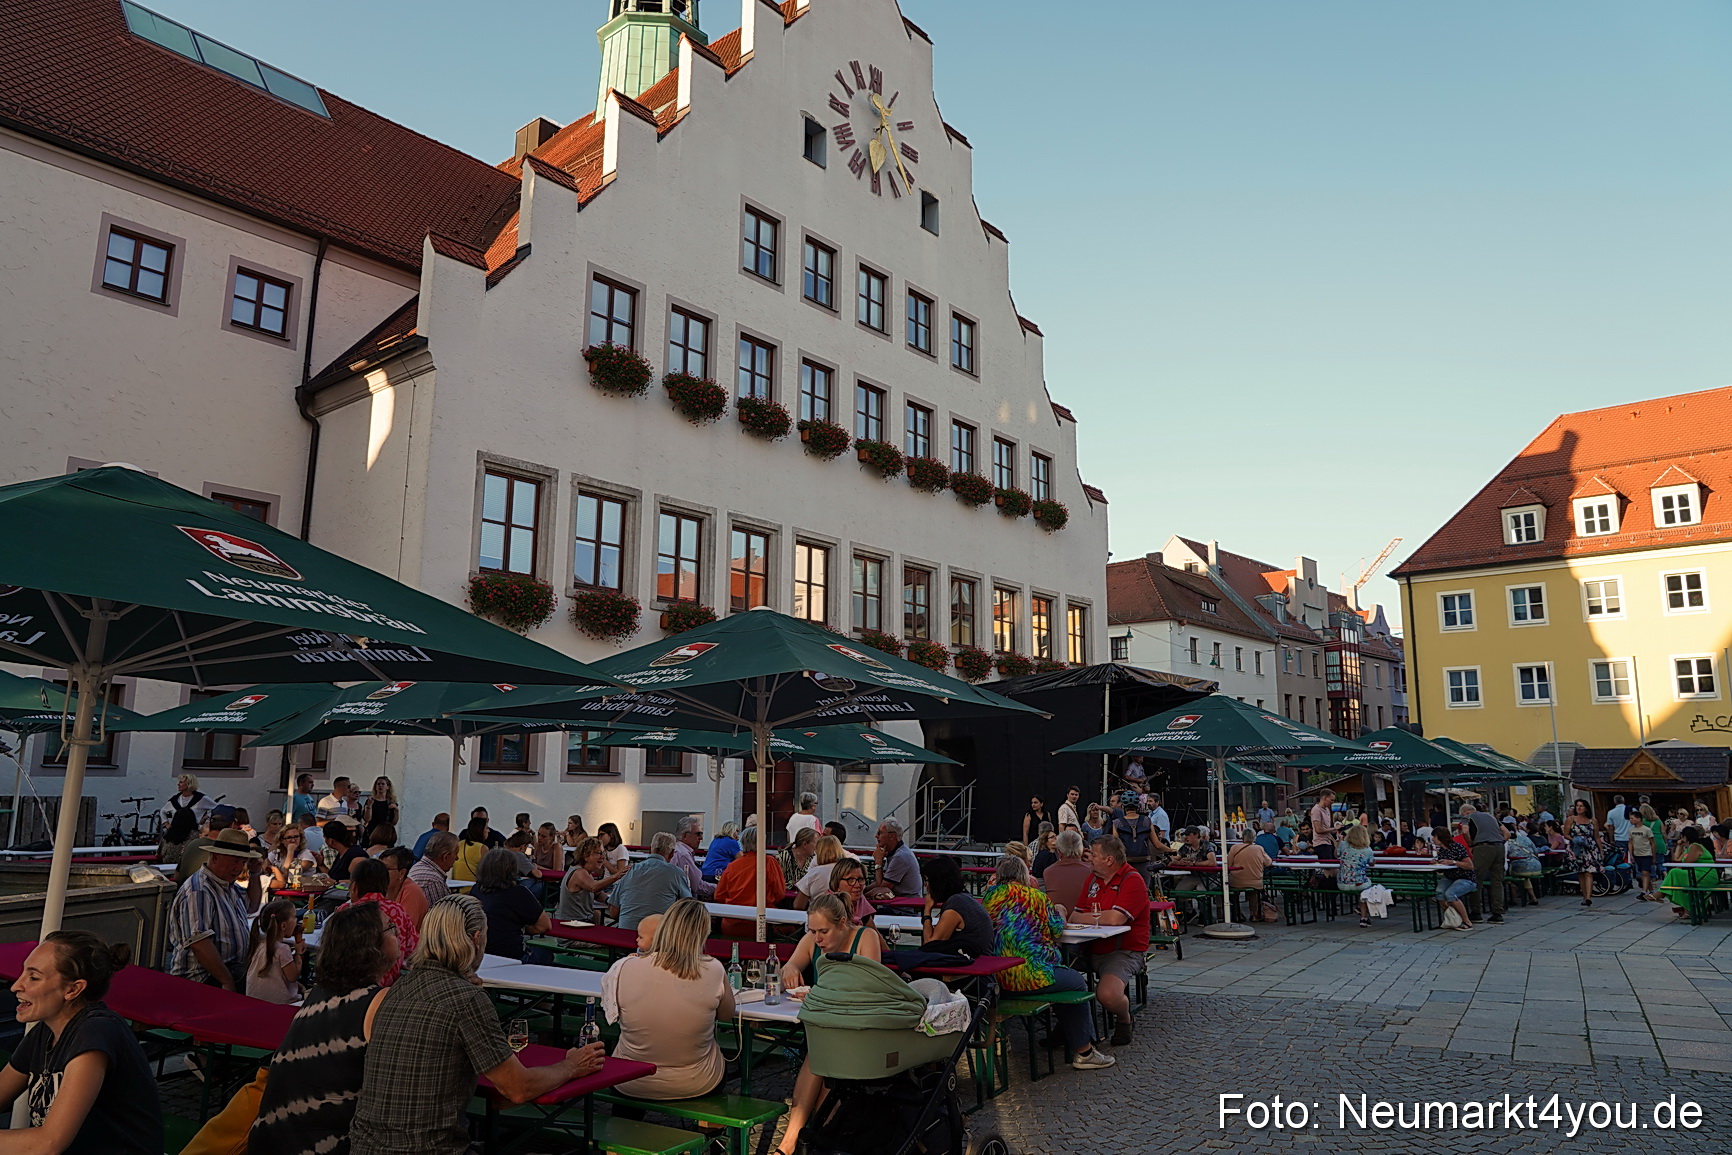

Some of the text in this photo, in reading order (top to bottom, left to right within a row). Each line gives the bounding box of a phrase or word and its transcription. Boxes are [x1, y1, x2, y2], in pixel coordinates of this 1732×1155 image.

[186, 578, 428, 635] Lammsbräu
[202, 570, 375, 612] Neumarkter
[1130, 734, 1202, 743] Lammsbräu
